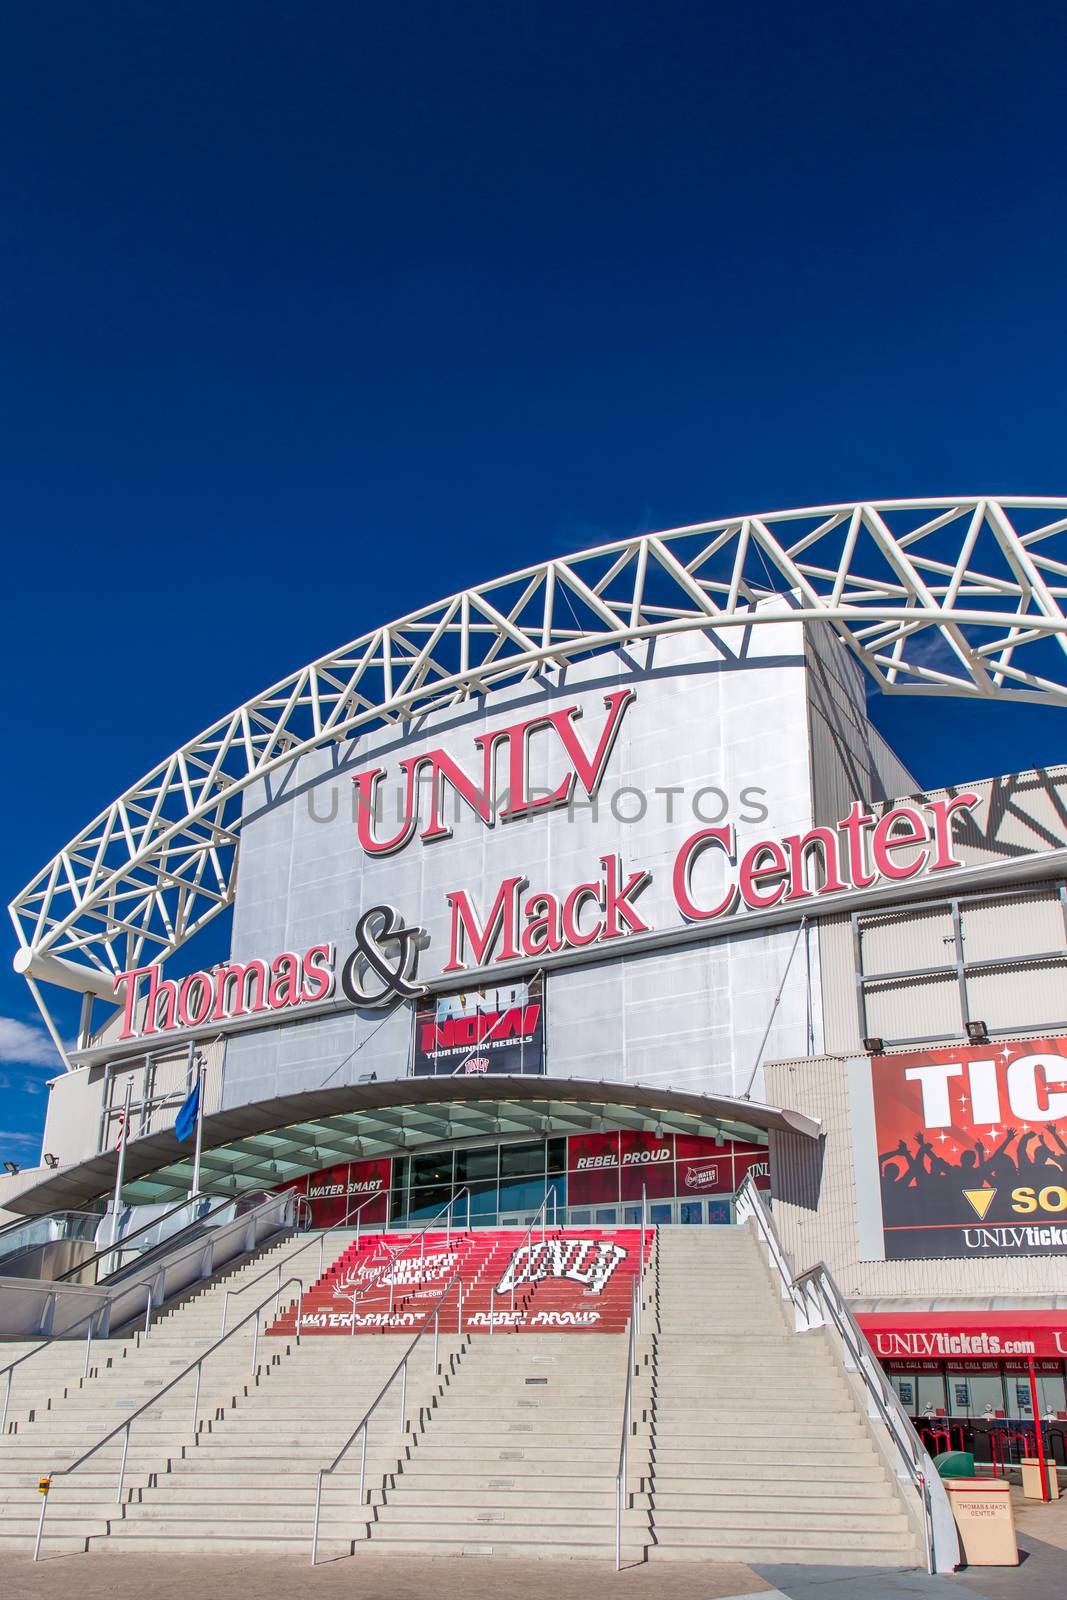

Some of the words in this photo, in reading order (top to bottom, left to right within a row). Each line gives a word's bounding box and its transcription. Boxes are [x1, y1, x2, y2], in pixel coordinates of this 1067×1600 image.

[351, 687, 637, 858] UNLV
[112, 942, 336, 1041] Thomas
[342, 904, 430, 1009] &
[441, 852, 653, 974] Mack
[672, 793, 983, 922] Center
[434, 982, 529, 1023] AND
[421, 1003, 540, 1053] NOW
[426, 1049, 451, 1059] YOUR
[492, 1036, 533, 1048] REBELS
[577, 1154, 620, 1169] REBEL
[622, 1148, 671, 1165] PROUD
[310, 1184, 344, 1197] WATER
[346, 1180, 383, 1193] SMART
[1011, 1185, 1067, 1213] SO
[295, 1313, 358, 1327] WATER
[356, 1312, 425, 1327] SMART
[467, 1312, 527, 1325] REBEL
[531, 1312, 600, 1325] PROUD
[875, 1332, 1036, 1355] UNLVtickets.com
[890, 1361, 905, 1369] WILL
[906, 1361, 921, 1369] CALL
[947, 1361, 963, 1369] WILL
[1005, 1361, 1022, 1369] WILL
[1023, 1361, 1040, 1369] CLL
[1042, 1361, 1059, 1369] ONLY
